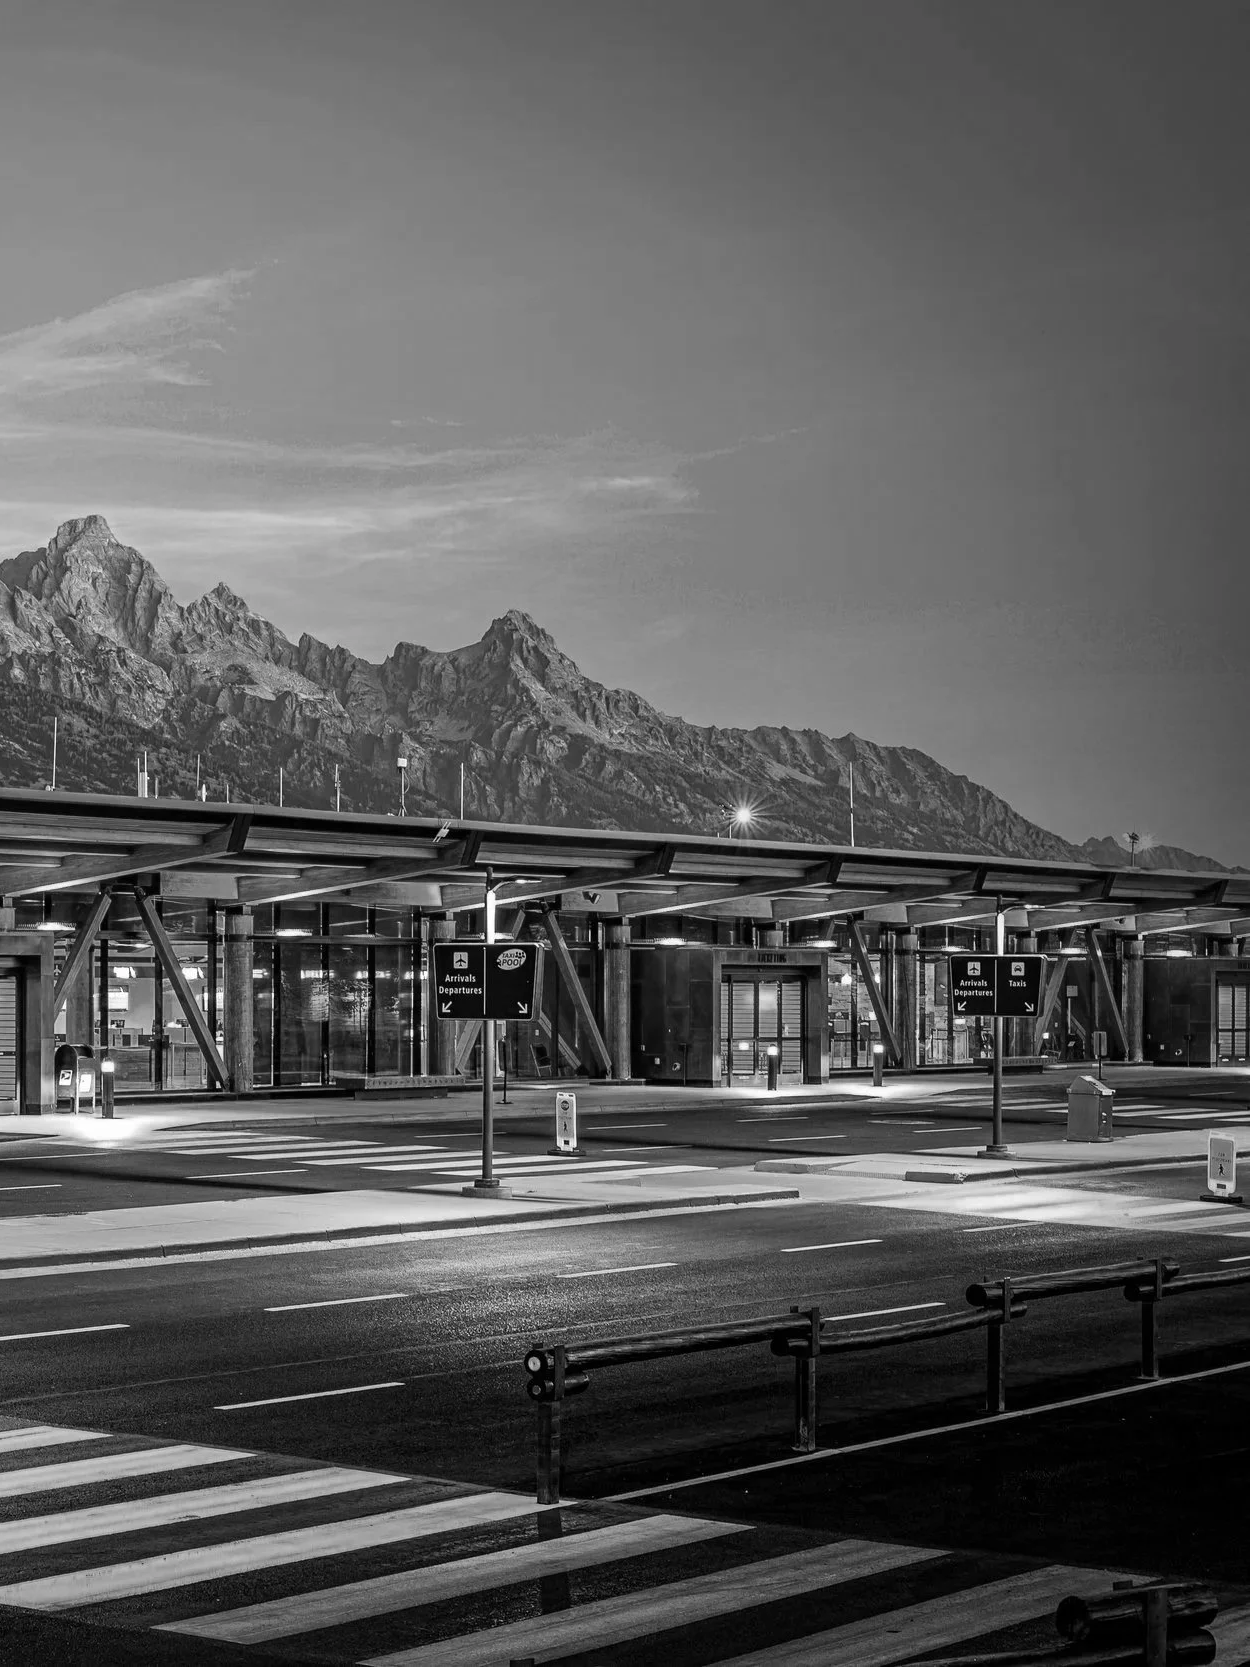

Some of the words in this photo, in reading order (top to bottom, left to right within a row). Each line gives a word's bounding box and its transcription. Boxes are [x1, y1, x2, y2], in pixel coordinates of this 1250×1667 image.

[445, 974, 476, 982] Arrivals
[960, 979, 988, 987] Arrivals
[439, 986, 482, 996] Departures
[954, 989, 993, 997] Departures
